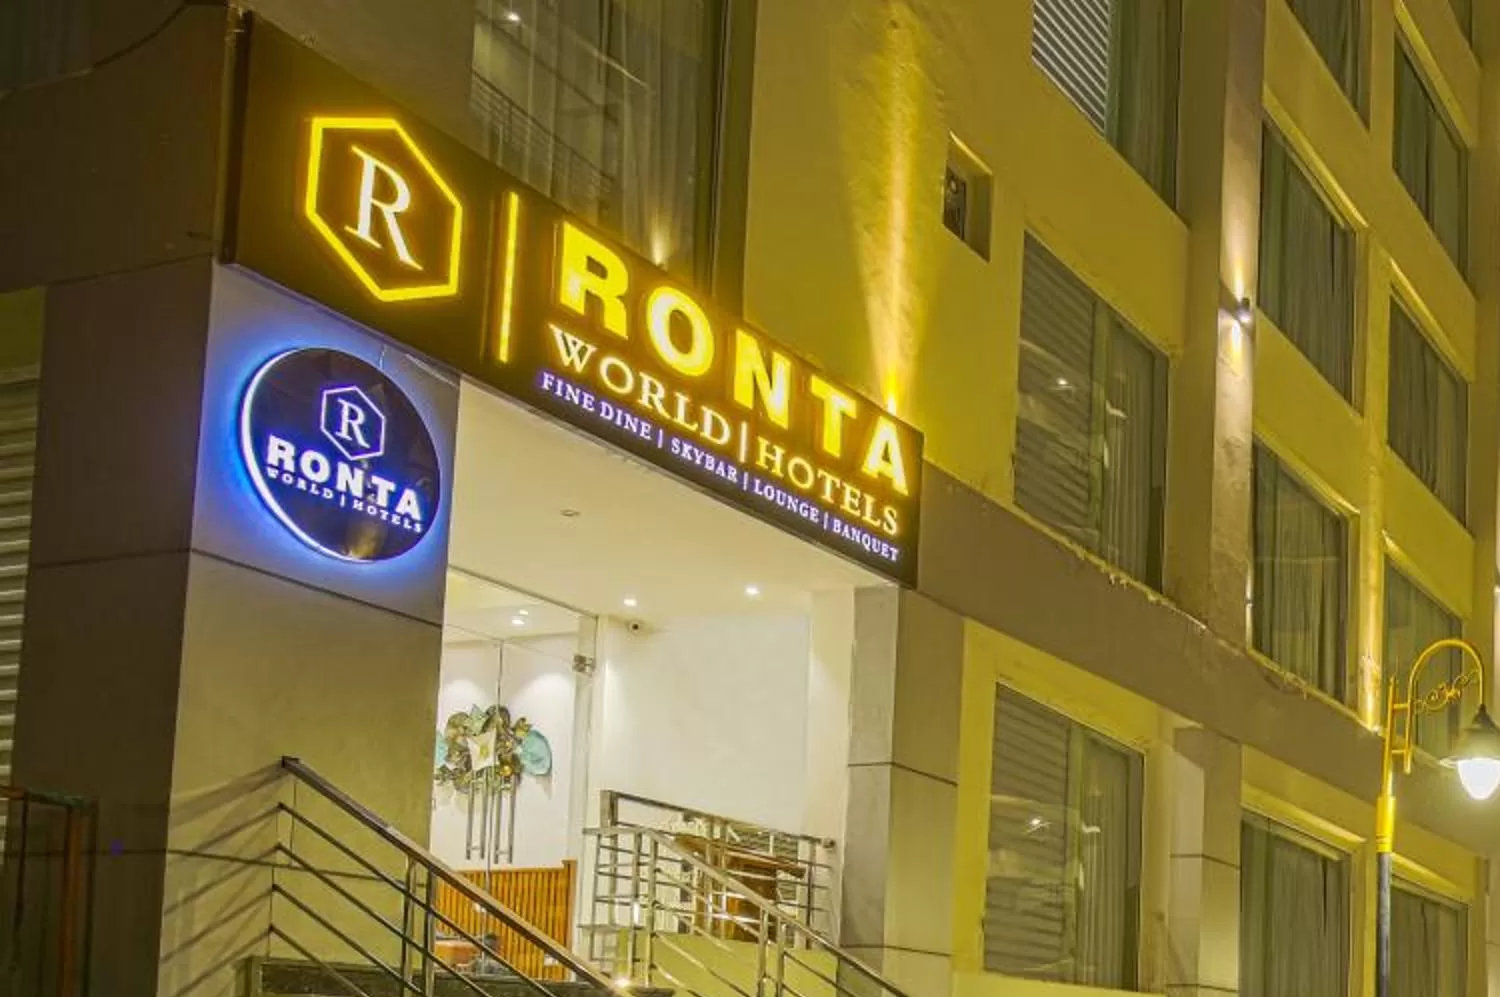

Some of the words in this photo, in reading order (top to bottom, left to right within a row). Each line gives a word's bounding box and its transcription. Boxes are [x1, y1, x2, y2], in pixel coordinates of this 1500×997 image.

[344, 145, 424, 271] R
[558, 219, 912, 498] RONTA
[265, 433, 422, 522] RONTA
[335, 397, 371, 450] R
[541, 370, 596, 413] FINE
[599, 395, 652, 441] DINE
[670, 436, 738, 484] SKYBAR
[753, 478, 820, 524] LOUNGE
[832, 518, 899, 563] BANQUET
[548, 322, 731, 447] WORLD
[754, 434, 899, 537] HOTELS
[265, 465, 334, 500] WORLD
[352, 500, 423, 534] HOTELS
